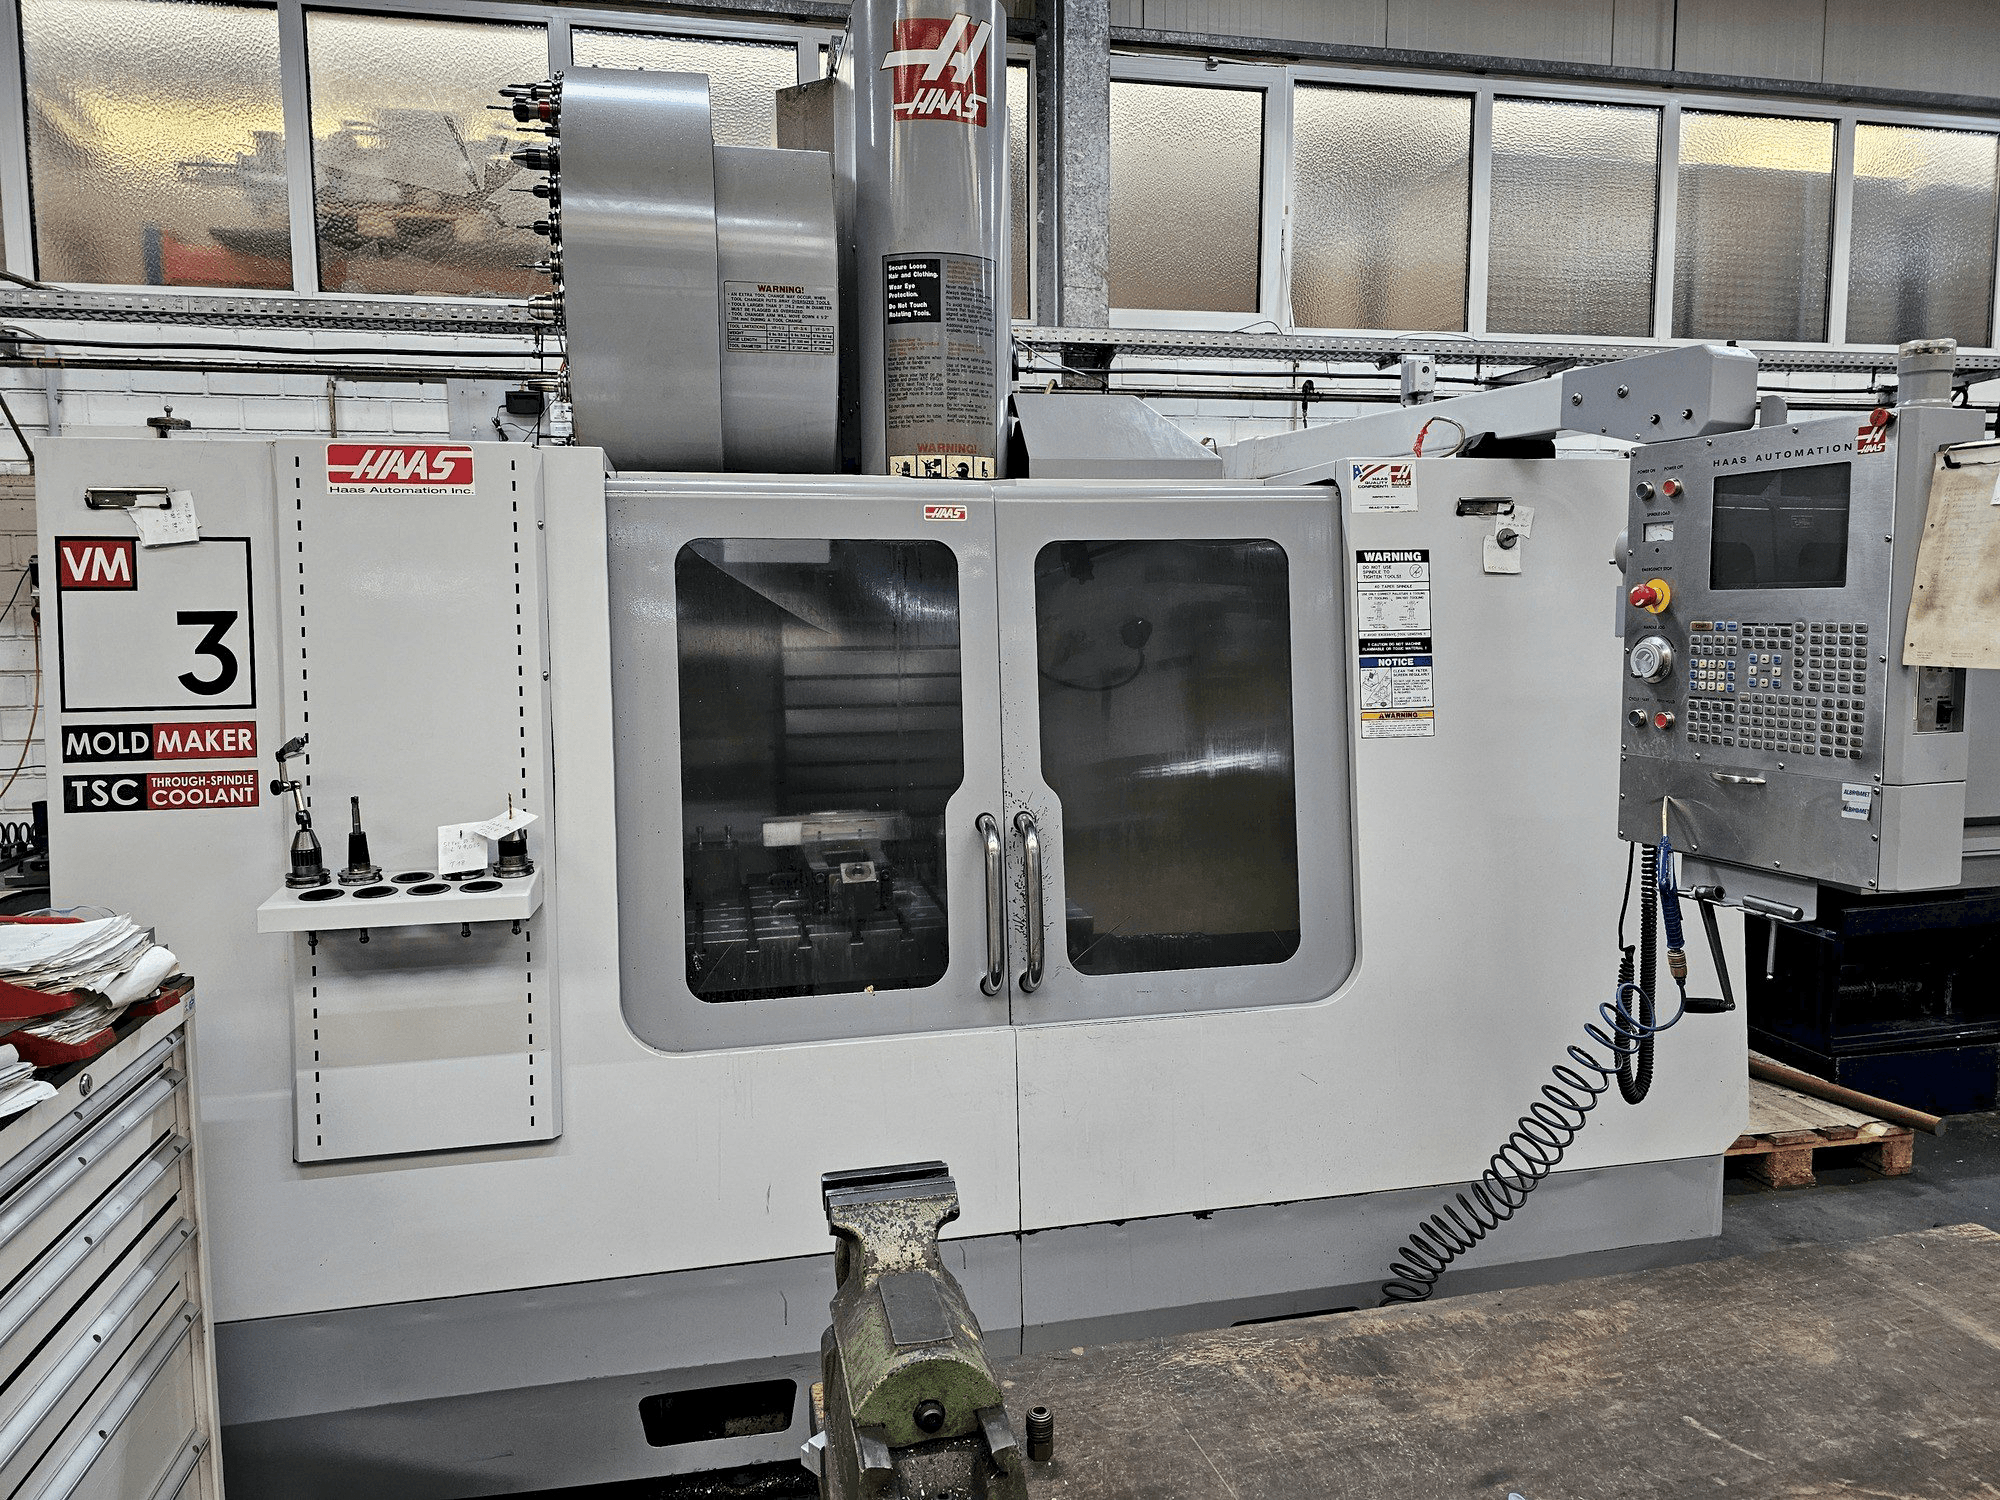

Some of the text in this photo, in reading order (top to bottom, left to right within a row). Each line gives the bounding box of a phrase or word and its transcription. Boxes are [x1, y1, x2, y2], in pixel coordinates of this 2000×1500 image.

[894, 88, 987, 119] HAAS
[757, 285, 804, 294] WARNING!
[917, 443, 977, 454] WARNING!
[1713, 443, 1852, 467] HAAS AUTOMATION
[1857, 442, 1886, 454] HAAS
[330, 449, 473, 480] HAAS
[369, 486, 447, 494] Automation
[925, 507, 966, 518] HAAS
[63, 547, 131, 582] VM
[1364, 552, 1422, 562] WARNING
[176, 610, 238, 696] 3
[1378, 658, 1414, 666] NOTICE
[66, 728, 252, 755] MOLD MAKER
[71, 774, 254, 807] TSC THROUGH-SPINDLE
[151, 787, 254, 806] COOLANT
